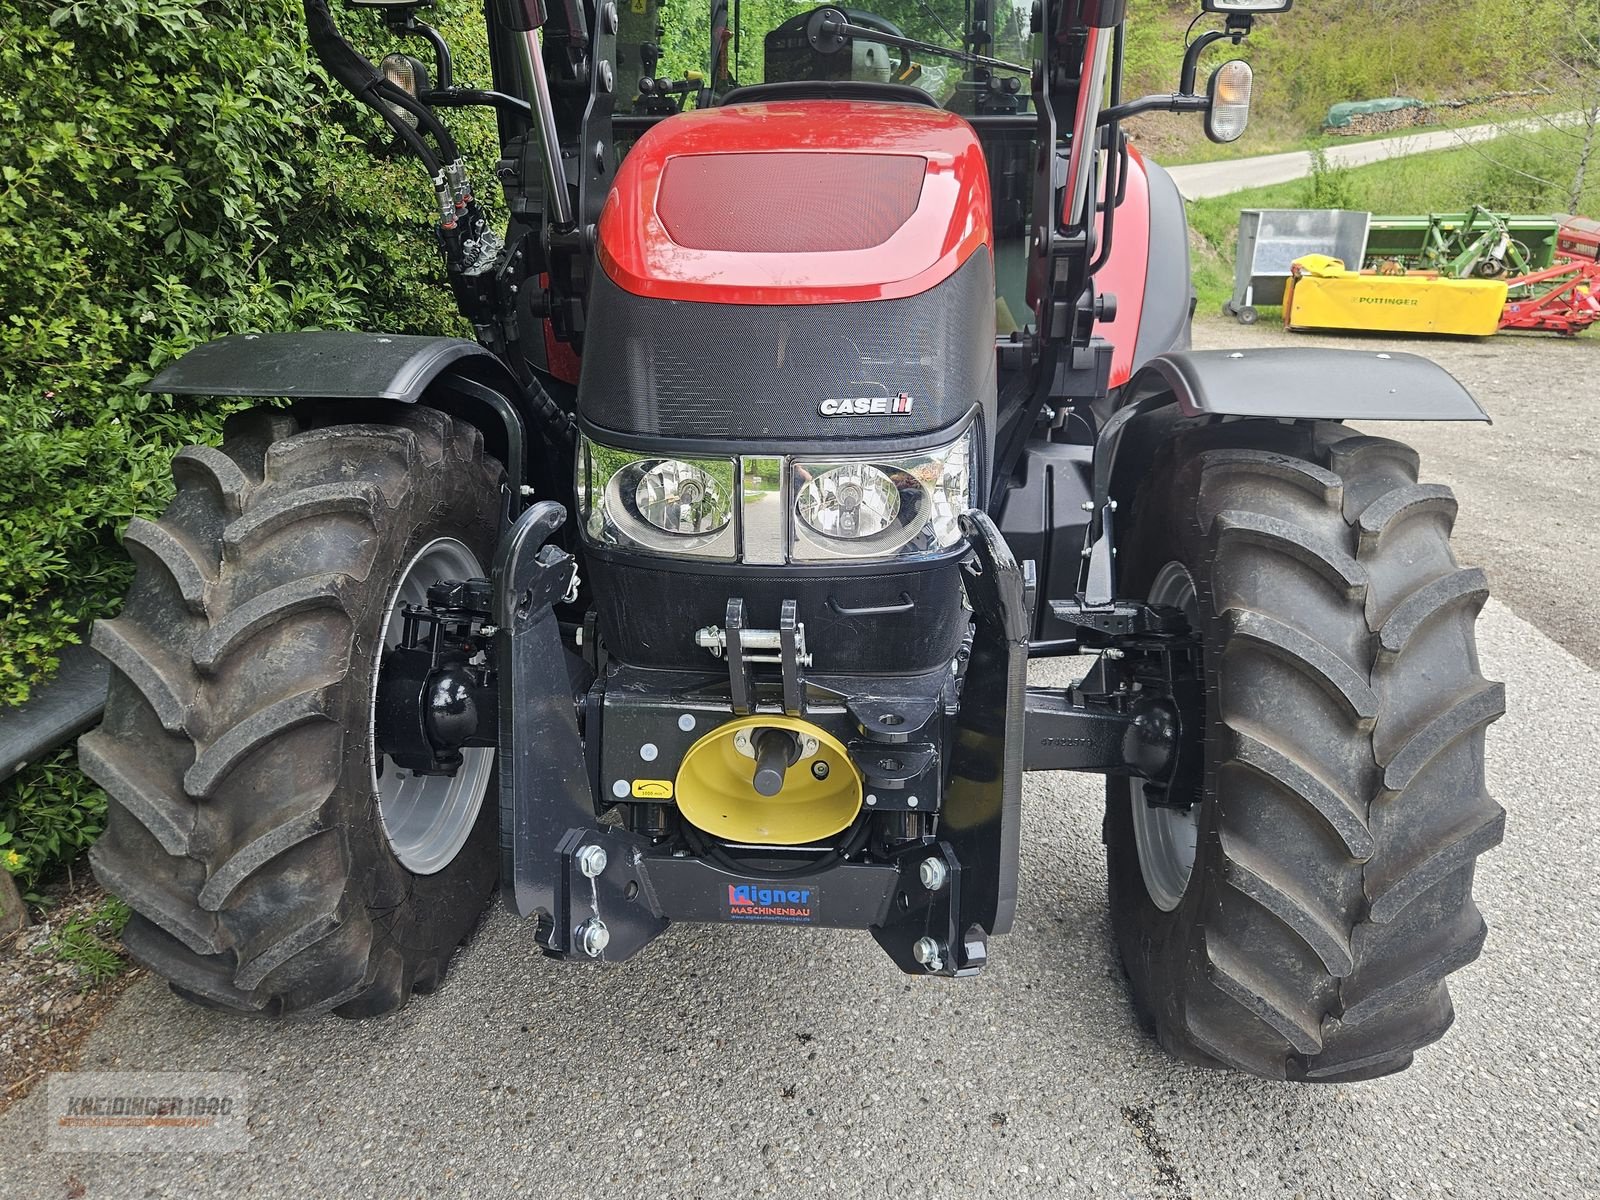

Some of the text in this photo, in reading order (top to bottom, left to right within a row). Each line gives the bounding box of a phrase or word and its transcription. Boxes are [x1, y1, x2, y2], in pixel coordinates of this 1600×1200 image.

[820, 398, 887, 415] CASE
[732, 885, 811, 906] Aigner
[731, 907, 811, 916] MASCHINENBAU
